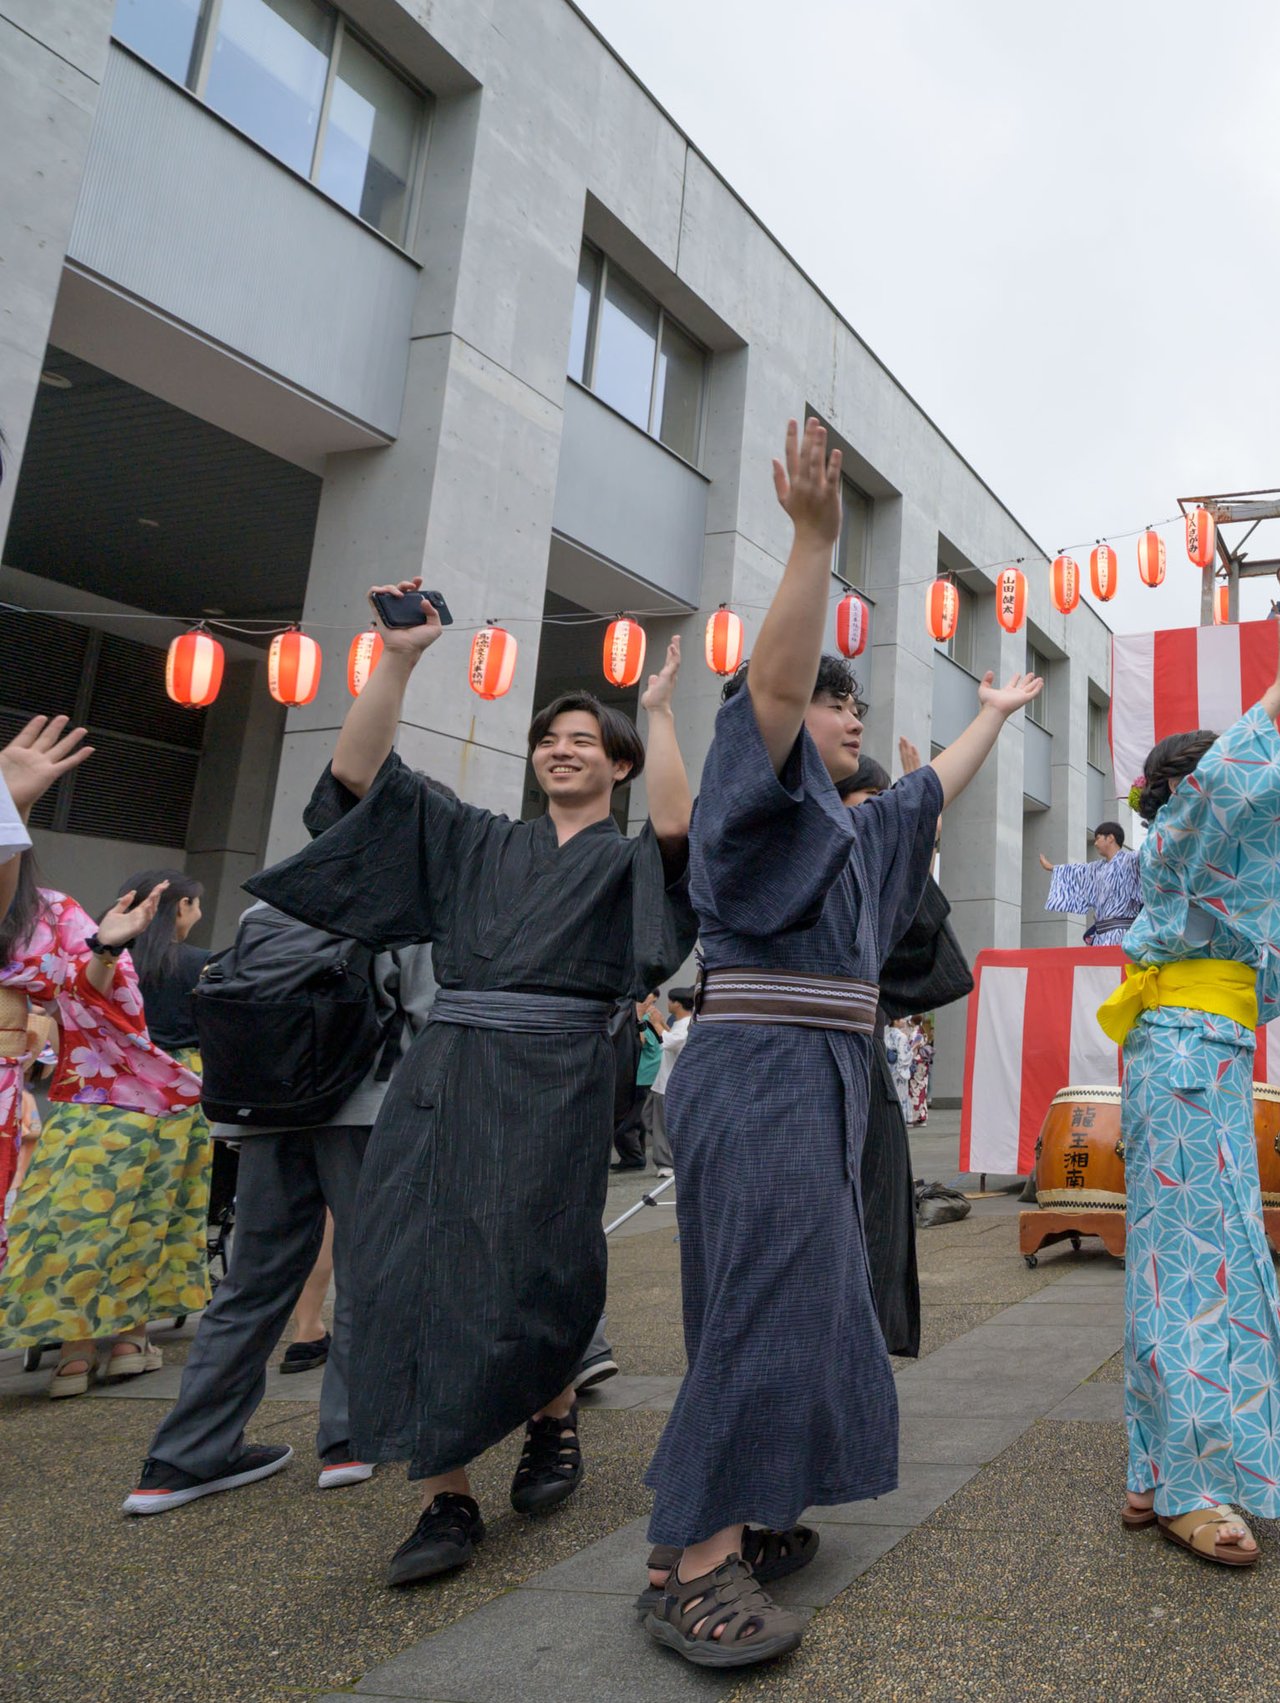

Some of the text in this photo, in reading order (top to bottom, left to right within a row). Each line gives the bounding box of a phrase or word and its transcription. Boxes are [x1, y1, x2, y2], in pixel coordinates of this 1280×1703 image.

[1002, 576, 1015, 615] 山田健太
[1064, 1106, 1097, 1188] 龍王湘南
